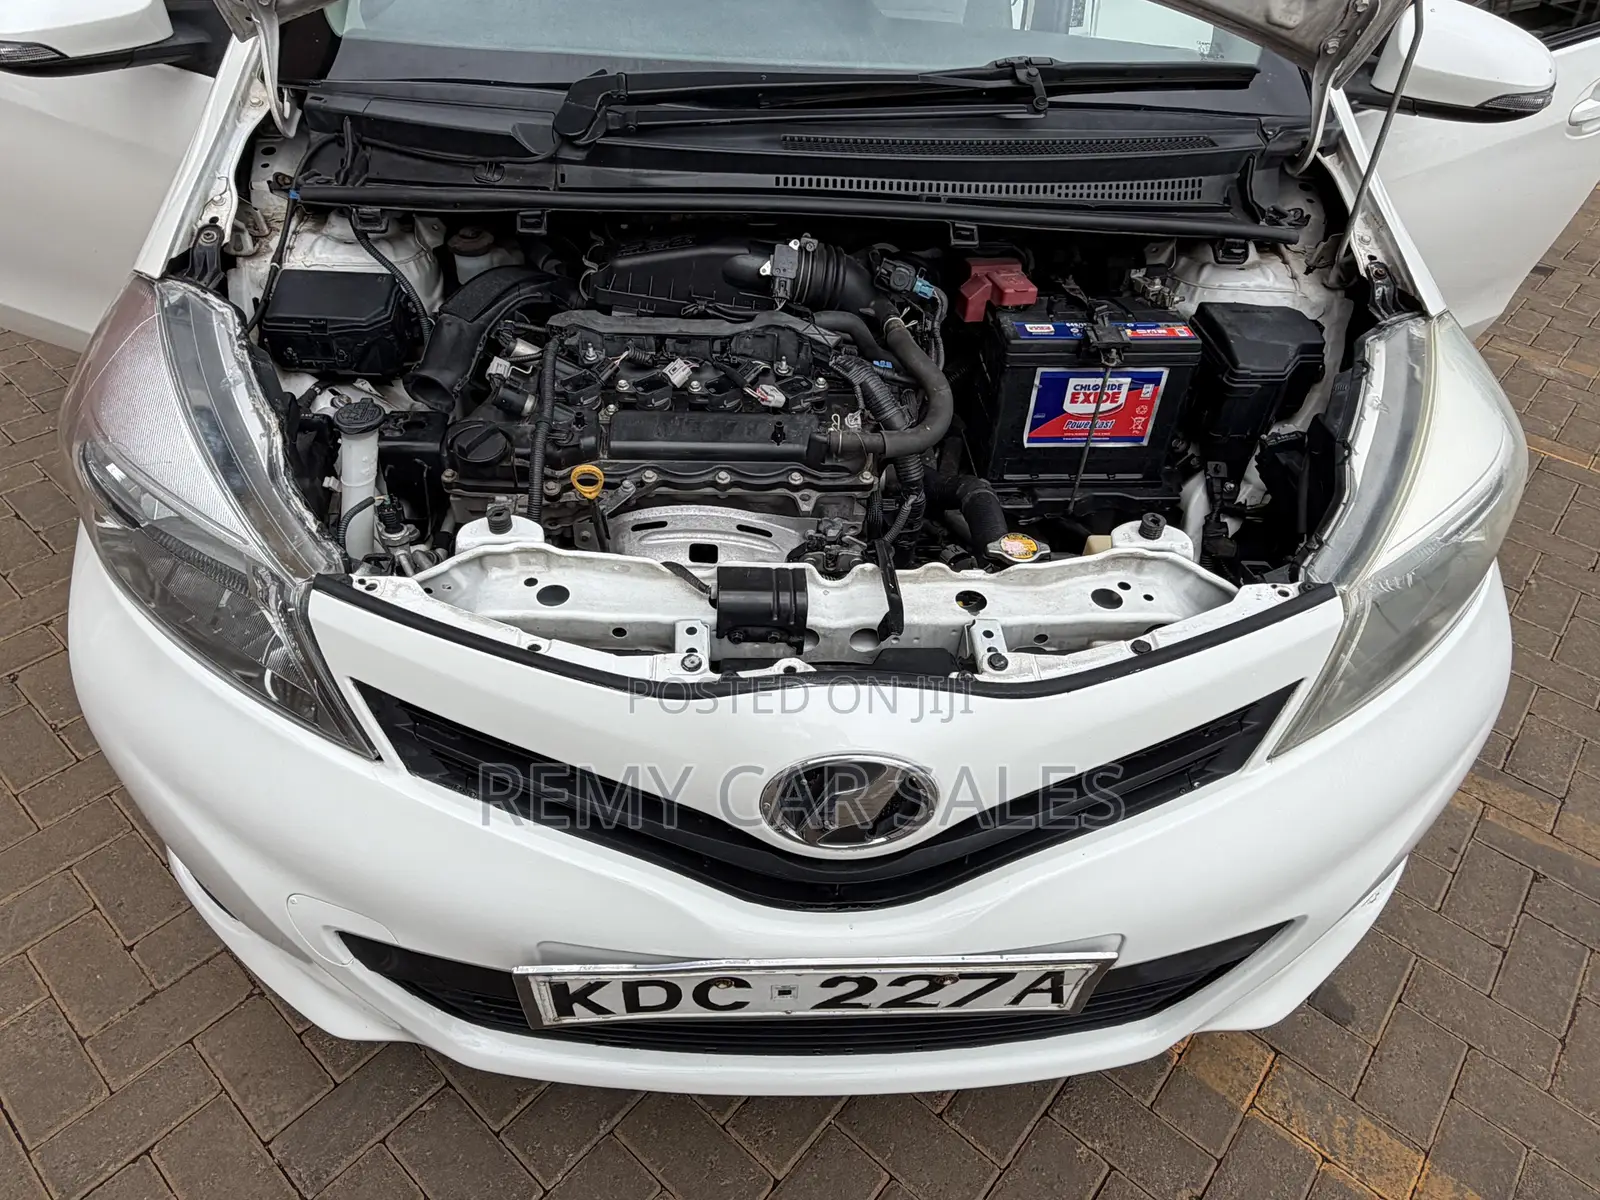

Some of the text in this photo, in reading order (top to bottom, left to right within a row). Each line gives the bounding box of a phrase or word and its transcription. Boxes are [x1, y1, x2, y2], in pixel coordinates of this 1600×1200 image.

[1073, 383, 1124, 391] CHLOIDE
[549, 970, 1066, 1018] KDC 227A
